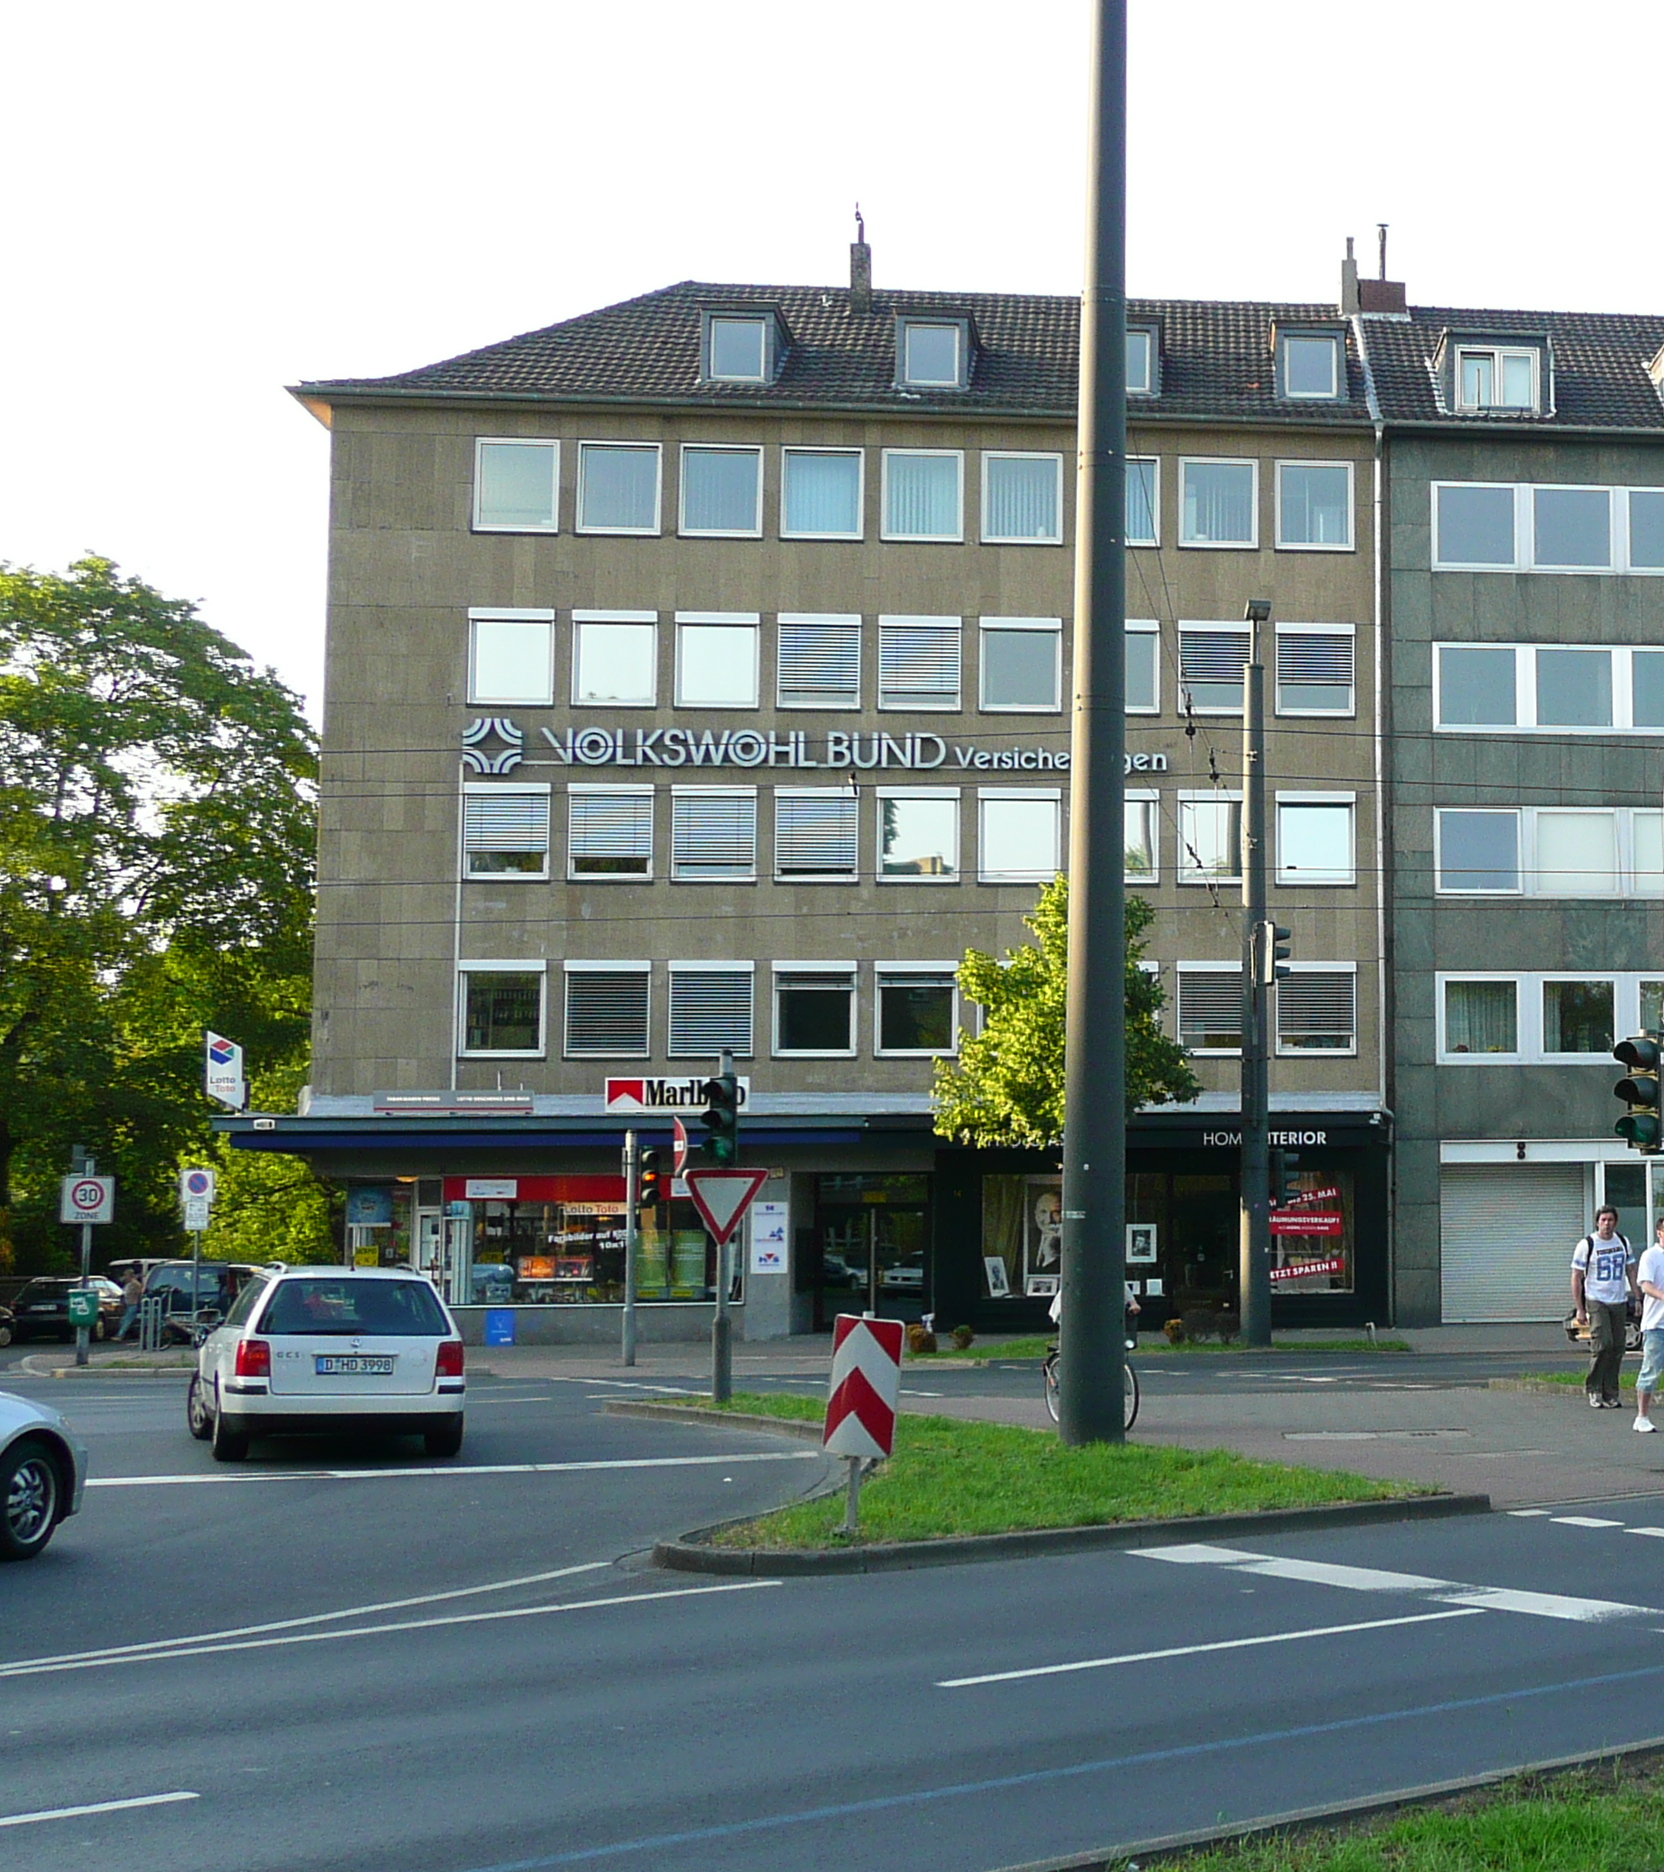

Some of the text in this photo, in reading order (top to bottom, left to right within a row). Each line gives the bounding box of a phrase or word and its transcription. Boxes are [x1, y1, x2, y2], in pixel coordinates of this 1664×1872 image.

[541, 726, 1168, 775] VOLKSWOHL BUND Versicheen
[210, 1076, 236, 1085] Lotto
[215, 1085, 236, 1093] Toto
[645, 1079, 746, 1106] Marlbo
[1203, 1131, 1327, 1146] HOM TERIOR
[78, 1188, 98, 1202] 30
[1317, 1188, 1337, 1199] MAI
[74, 1211, 100, 1220] ZONE
[564, 1204, 619, 1214] Lotto Toto
[1270, 1267, 1292, 1279] ETZT
[1293, 1261, 1329, 1276] SPAREN
[1597, 1253, 1625, 1281] 68
[325, 1357, 391, 1371] D HD 3998
